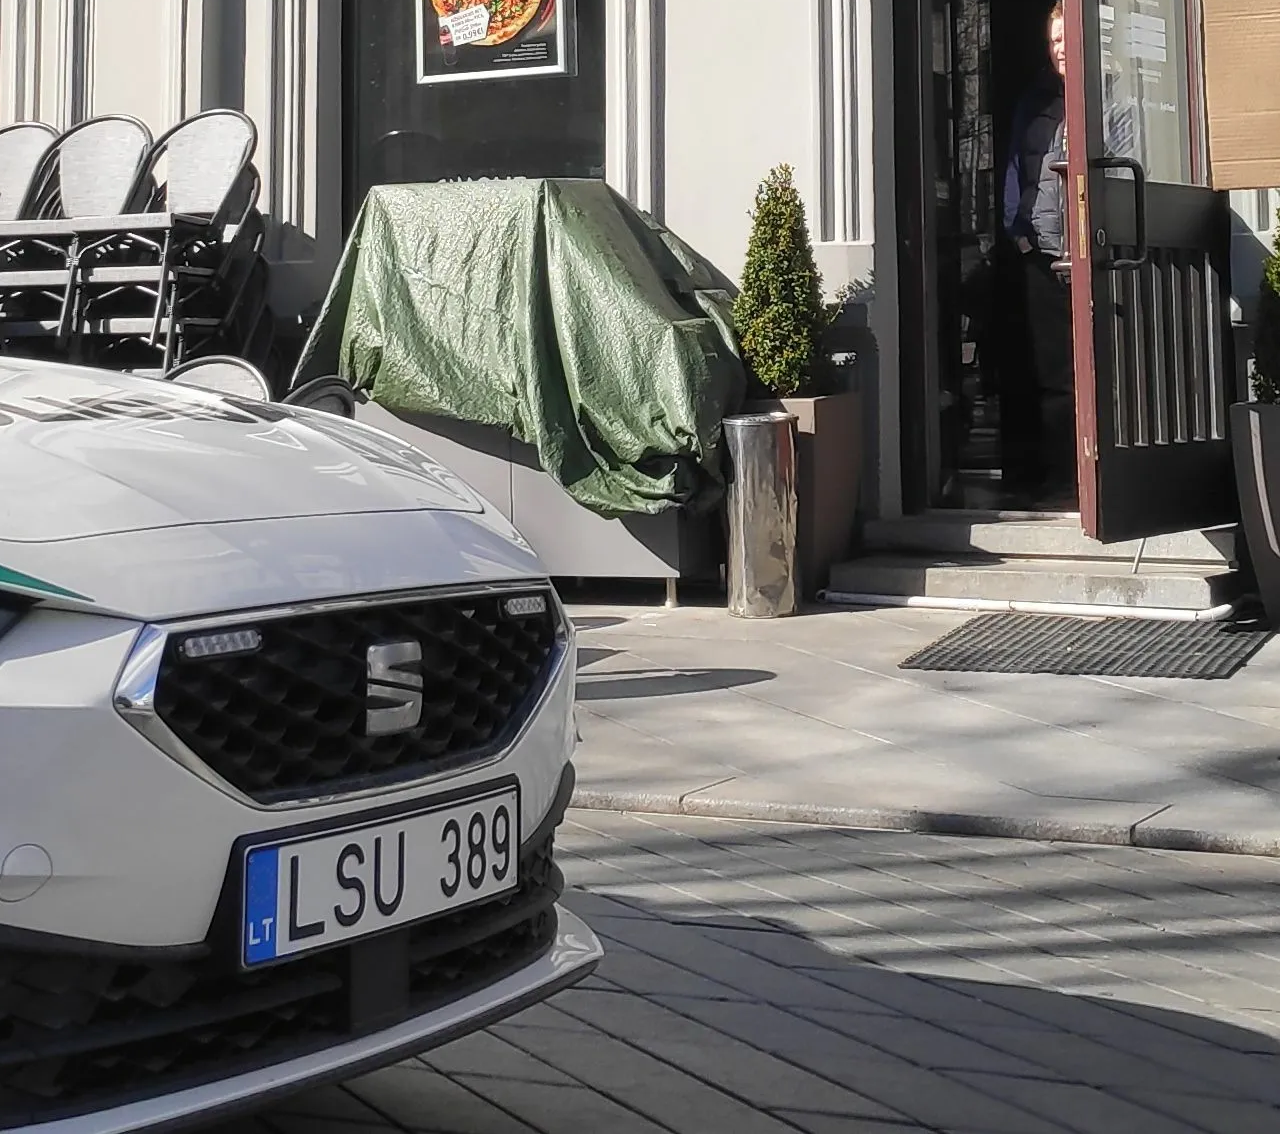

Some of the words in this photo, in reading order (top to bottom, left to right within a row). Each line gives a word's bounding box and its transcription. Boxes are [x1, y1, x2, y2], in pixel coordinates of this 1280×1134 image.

[288, 830, 406, 942] LSU
[440, 804, 511, 898] 389
[249, 917, 274, 946] LT
